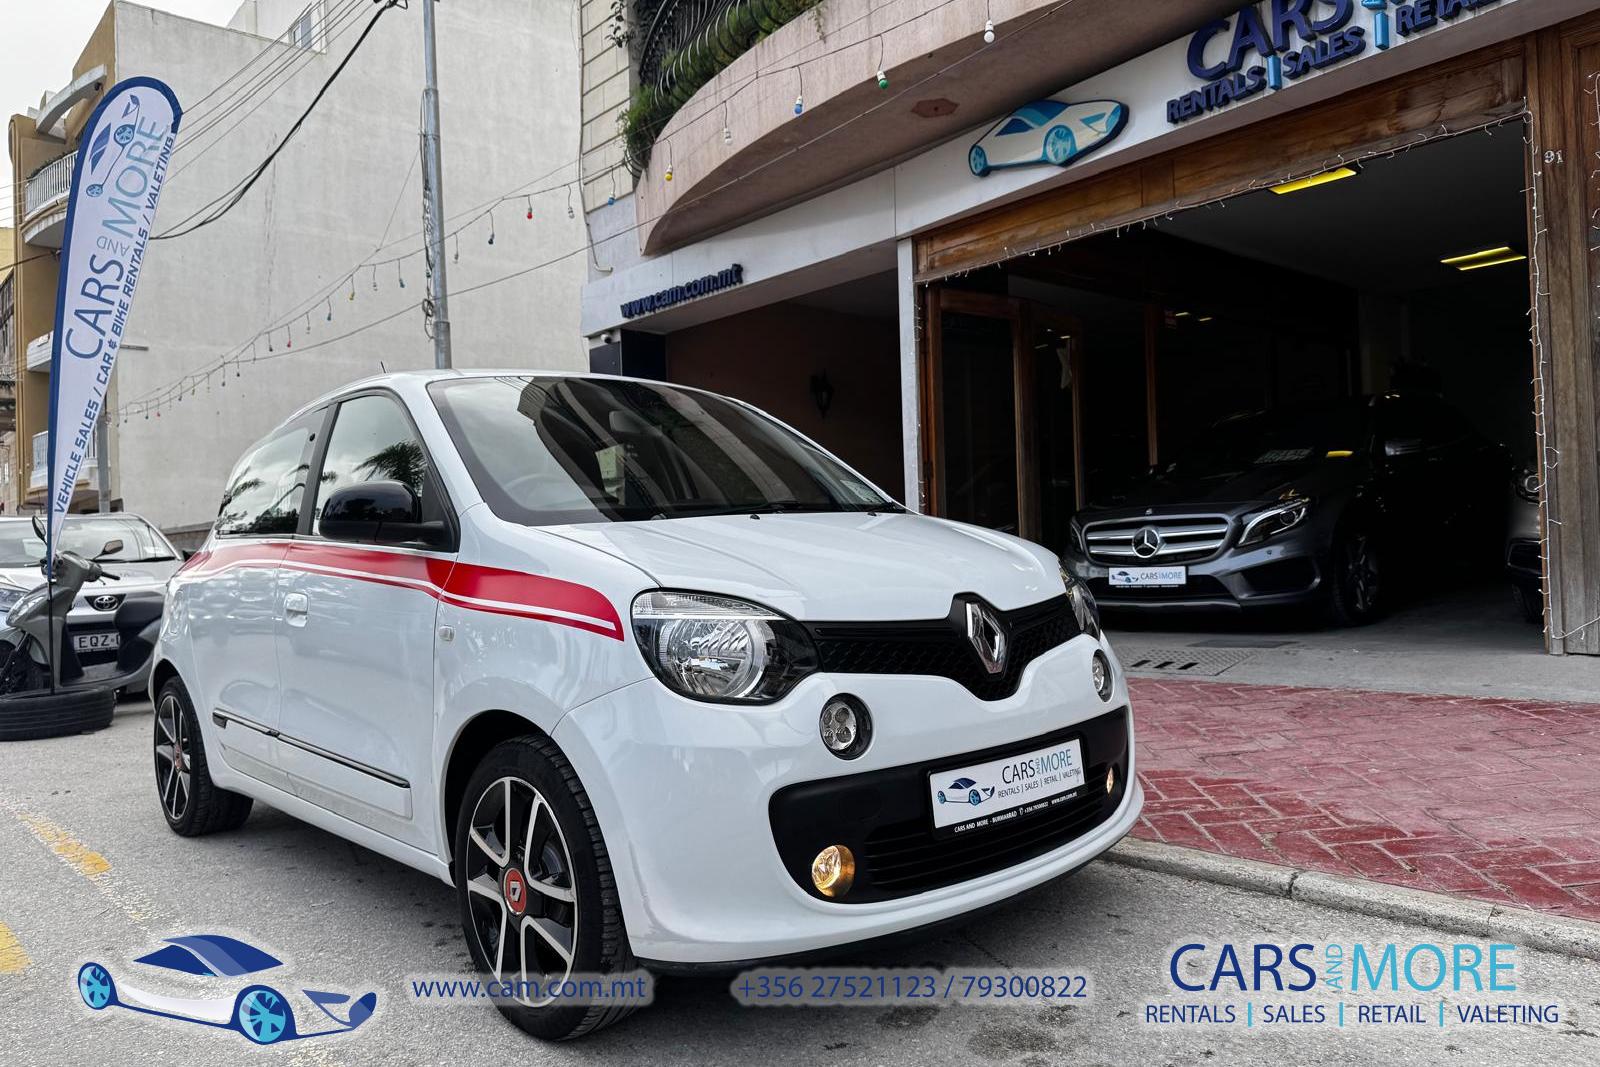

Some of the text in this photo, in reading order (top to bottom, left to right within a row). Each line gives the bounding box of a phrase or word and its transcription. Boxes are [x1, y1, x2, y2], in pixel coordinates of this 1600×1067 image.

[1167, 66, 1267, 124] RENTALS
[1283, 26, 1366, 79] SALES
[1543, 150, 1564, 164] 91
[65, 116, 164, 359] CARS AND MORE
[620, 263, 744, 319] www.cam.com.mt
[54, 451, 82, 514] VEHICLE
[75, 399, 100, 449] SALES
[96, 352, 115, 386] CAR
[111, 295, 130, 338] BIKE
[122, 229, 148, 295] RENTALS
[146, 136, 174, 211] VALETING
[1140, 571, 1182, 580] CARS MORE
[998, 767, 1081, 798] RENTALS SALES RETAIL VALETING
[1002, 760, 1036, 784] CARS
[1041, 749, 1073, 773] MORE
[954, 824, 966, 833] CARS
[966, 822, 976, 830] AND
[976, 819, 989, 828] MORE
